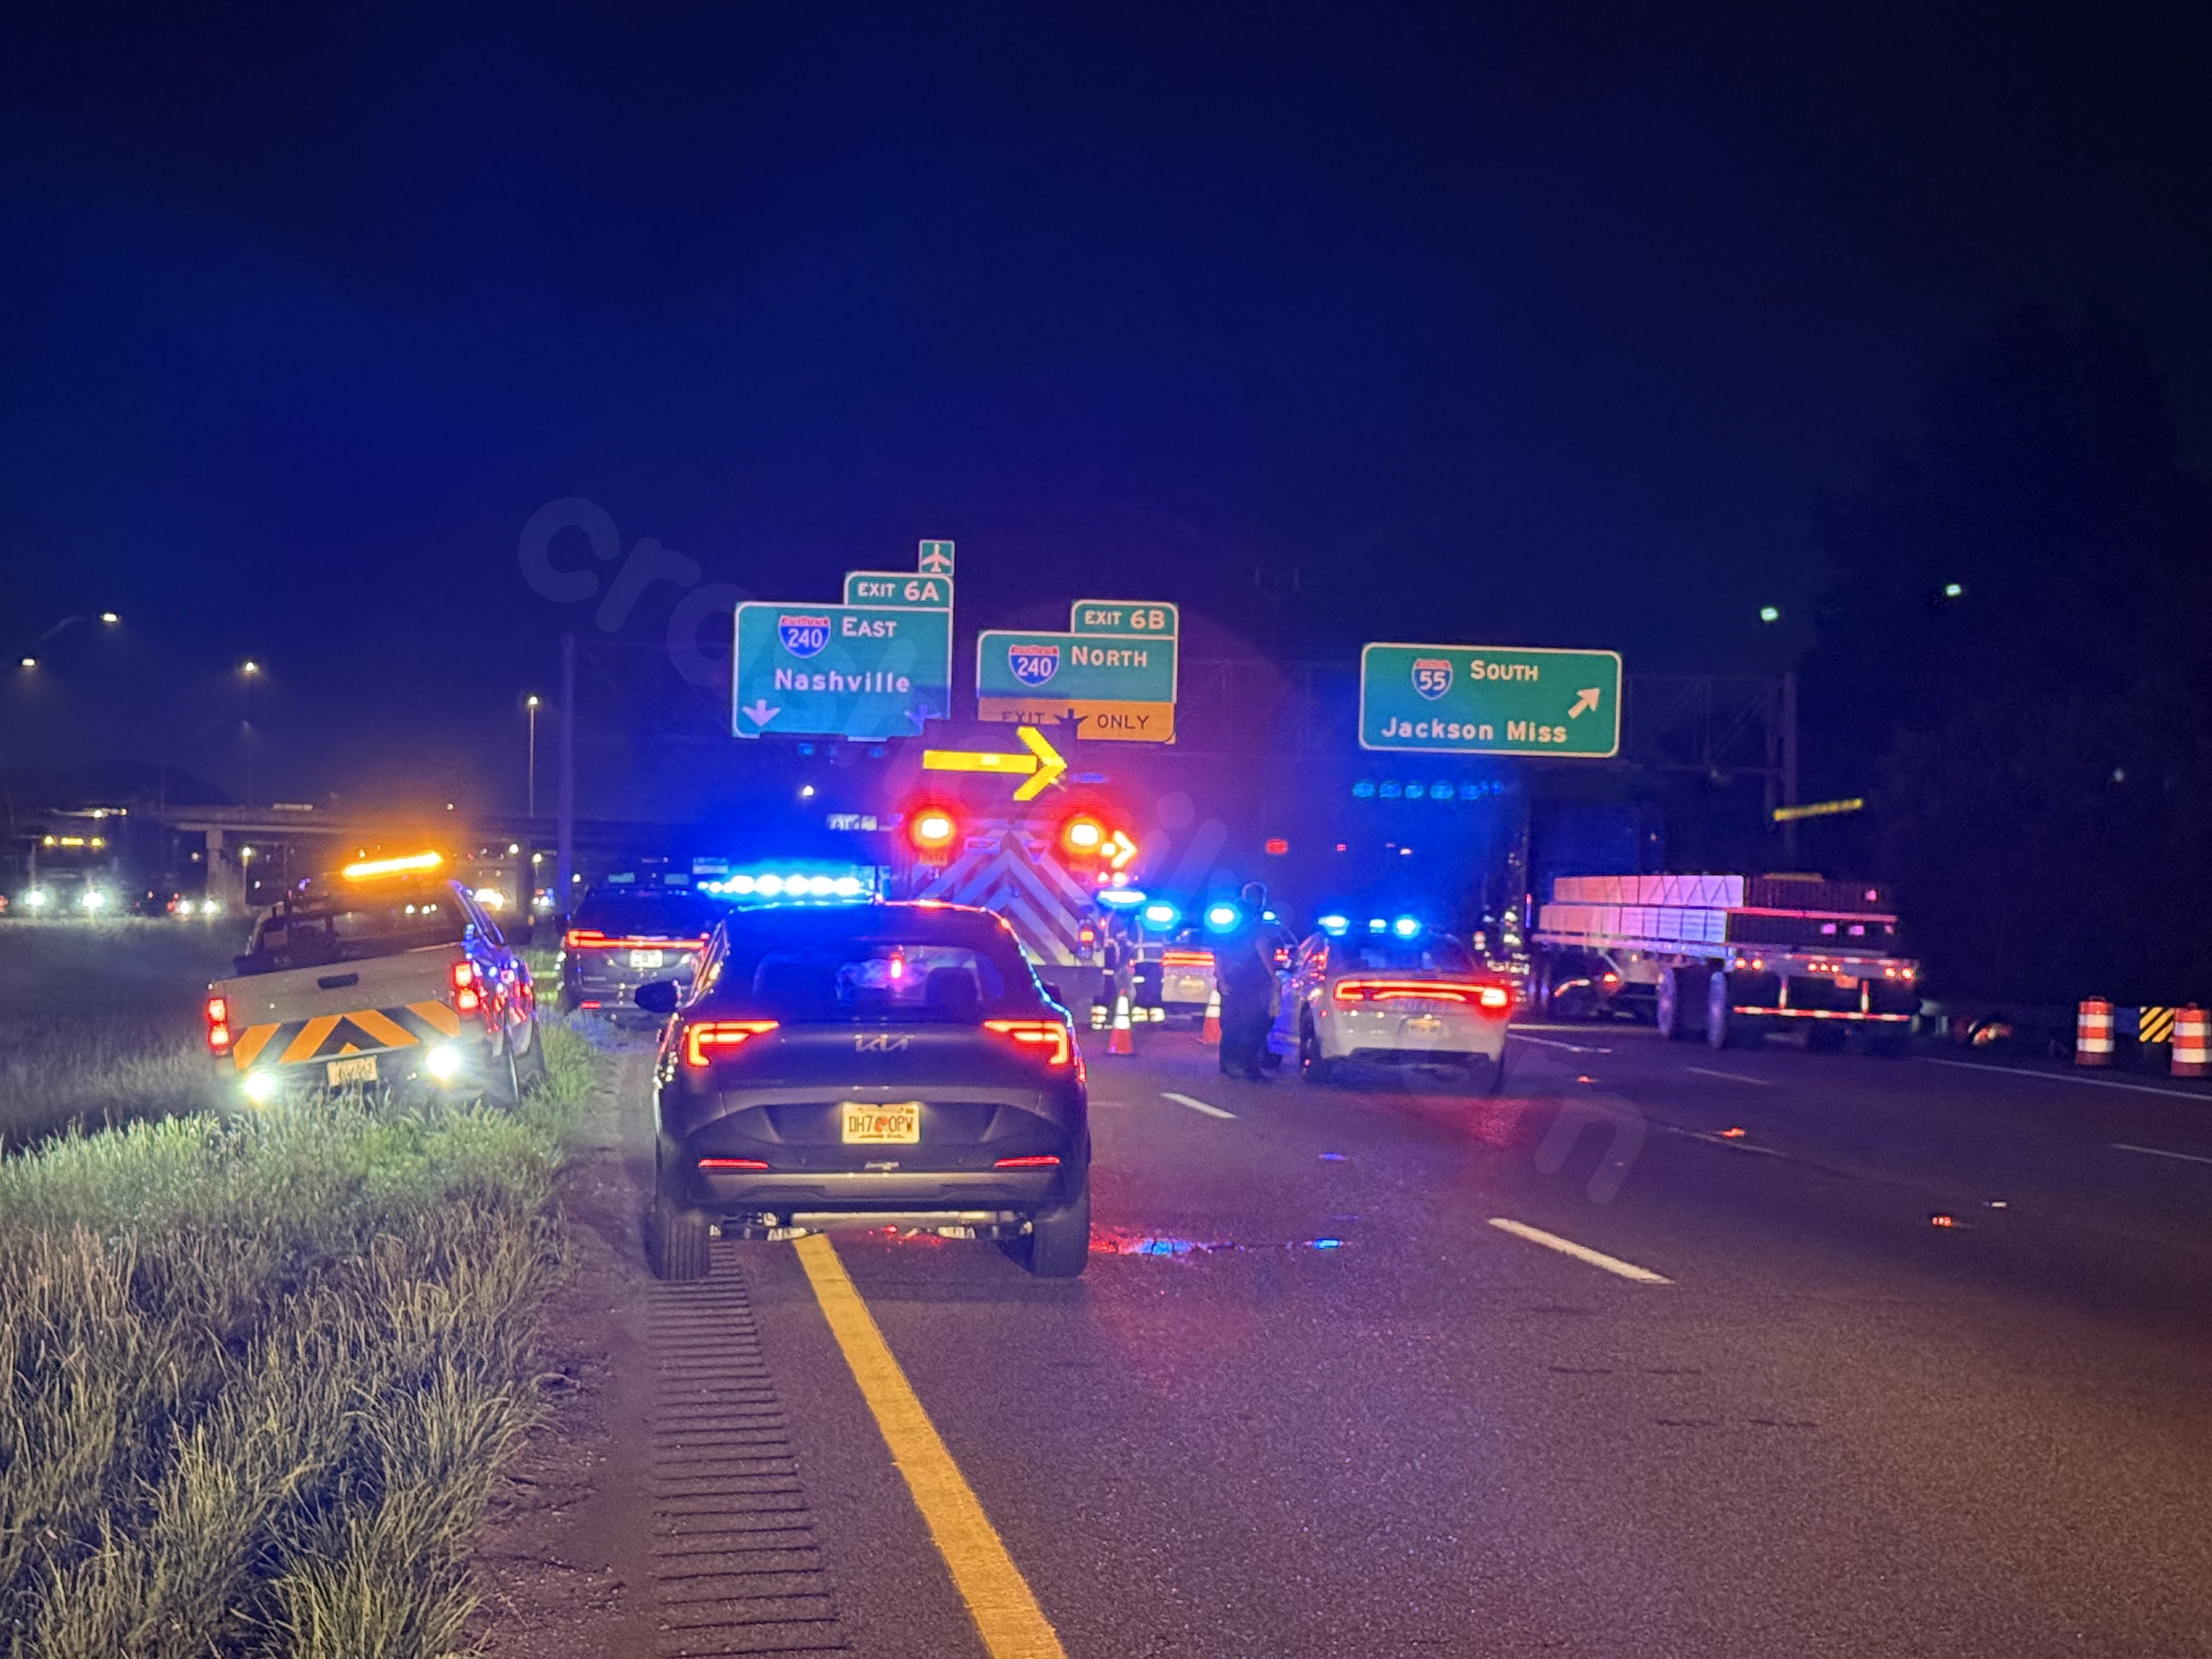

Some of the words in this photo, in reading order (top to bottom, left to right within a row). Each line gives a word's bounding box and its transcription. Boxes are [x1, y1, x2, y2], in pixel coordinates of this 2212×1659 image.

[857, 582, 896, 598] EXIT
[904, 581, 939, 601] 6A
[787, 628, 823, 648] 240
[842, 616, 897, 638] EAST
[1085, 610, 1122, 625] EXIT
[1130, 610, 1165, 630] 6B
[1017, 657, 1053, 678] 240
[1071, 645, 1148, 667] NORTH
[774, 668, 911, 693] Nashville
[1418, 671, 1446, 691] 55
[1470, 659, 1538, 681] SOUTH
[1097, 713, 1150, 730] ONLY
[1381, 716, 1493, 741] Jackson
[1506, 720, 1567, 744] Miss
